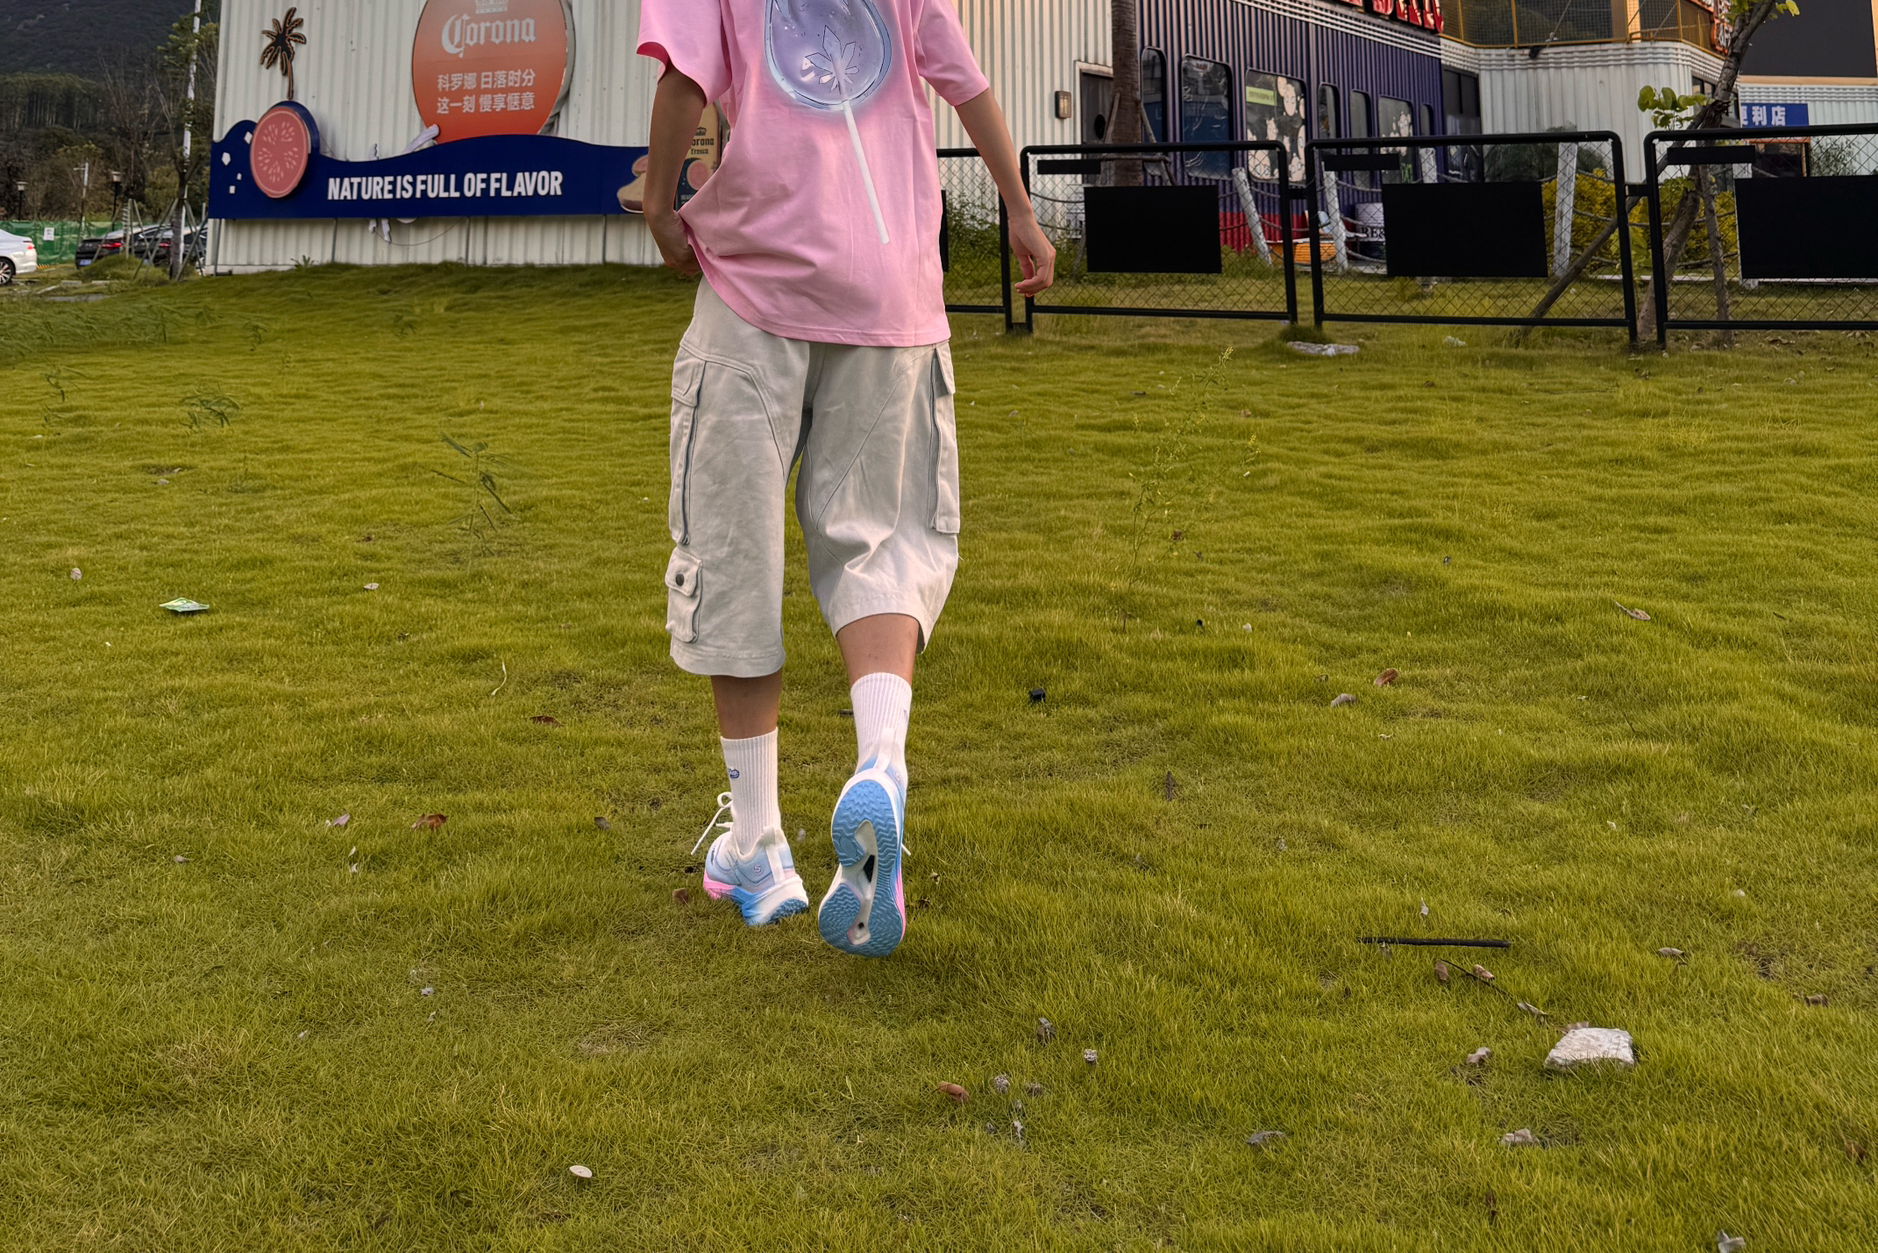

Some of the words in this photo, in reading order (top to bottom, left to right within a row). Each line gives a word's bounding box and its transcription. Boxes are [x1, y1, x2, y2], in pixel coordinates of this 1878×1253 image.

[441, 13, 536, 58] Corona
[437, 72, 477, 92] 科罗娜
[480, 68, 536, 89] 日落时分
[436, 94, 476, 115] 这一刻
[479, 91, 535, 113] 慢享惬意
[691, 137, 715, 146] orona
[327, 176, 394, 200] NATURE
[396, 175, 413, 198] IS
[415, 174, 460, 198] FULL
[463, 172, 487, 197] OF
[489, 170, 563, 197] FLAVOR
